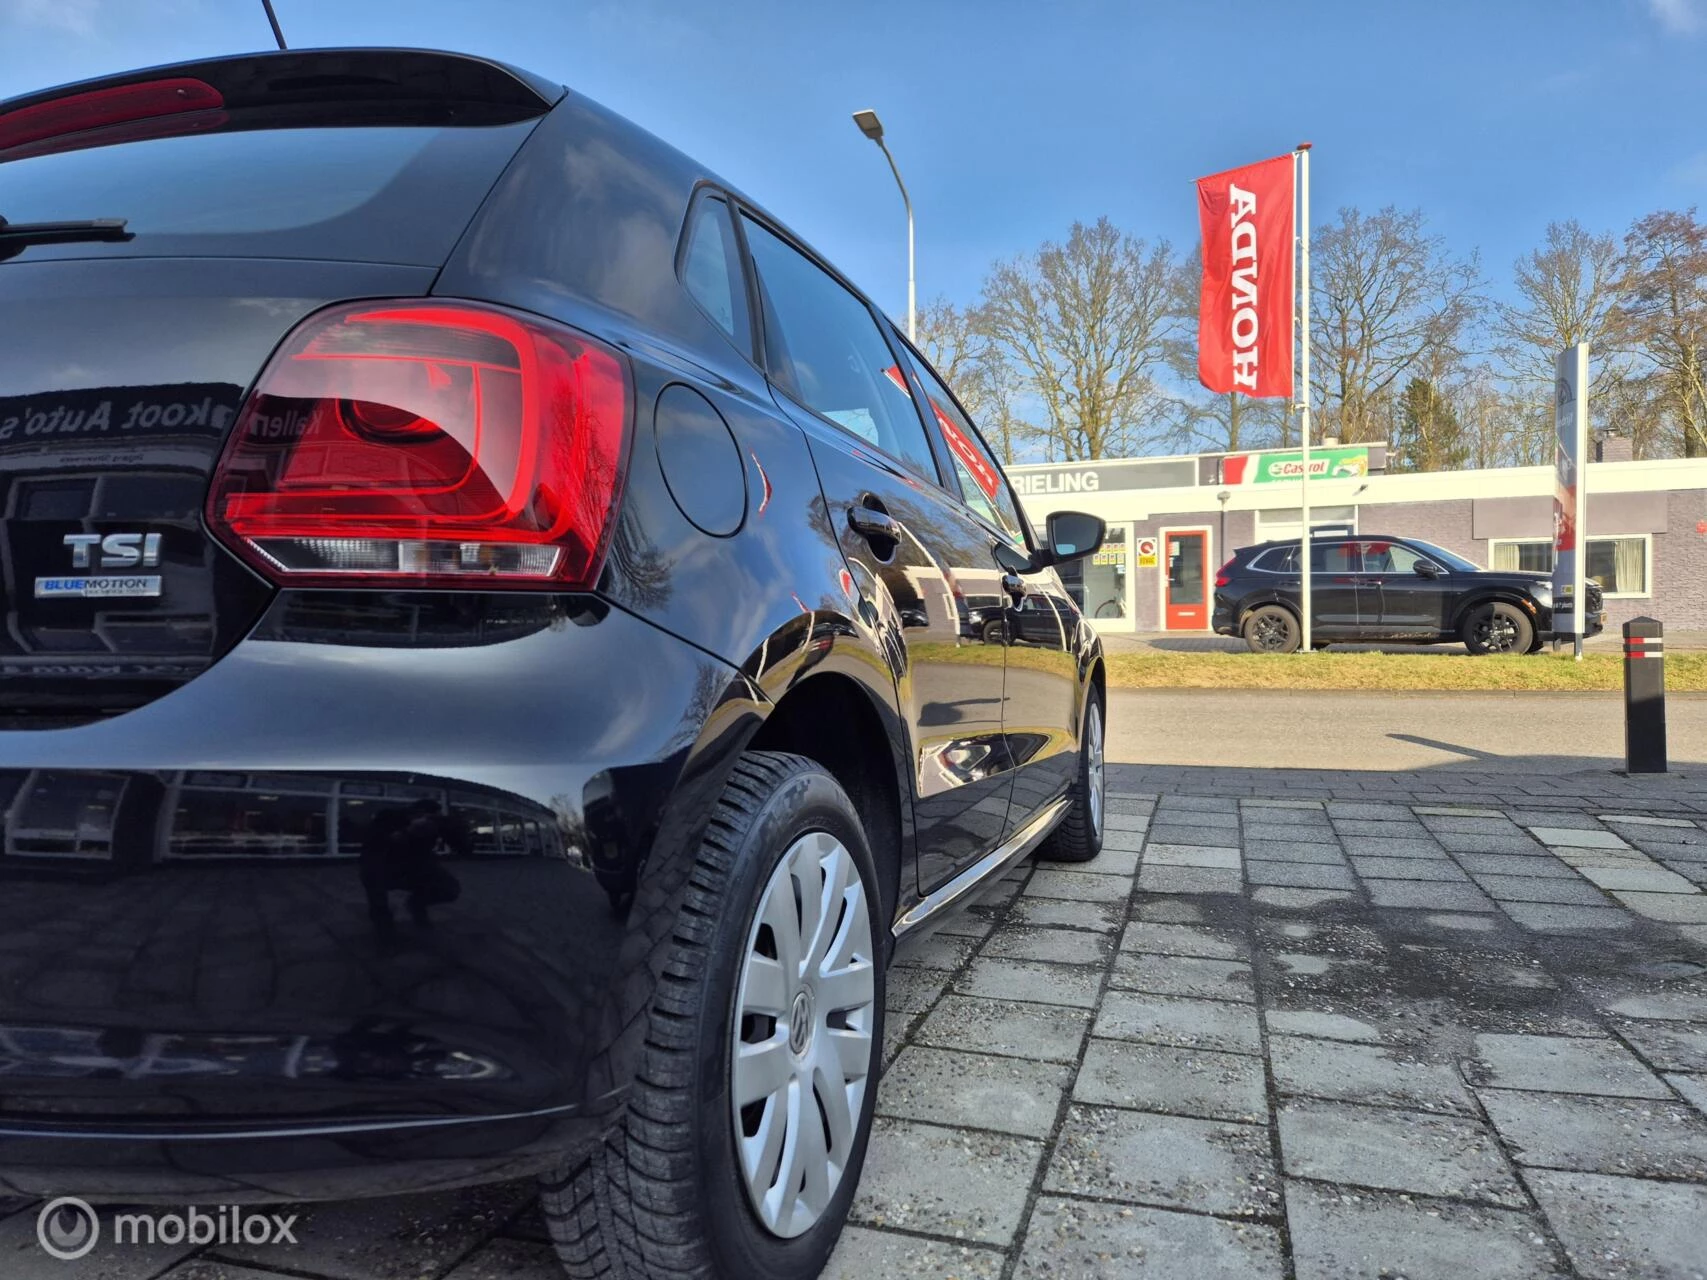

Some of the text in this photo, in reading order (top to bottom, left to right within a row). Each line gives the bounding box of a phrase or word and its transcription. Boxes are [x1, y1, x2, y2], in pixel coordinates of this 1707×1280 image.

[1229, 183, 1259, 390] HONDA
[1283, 461, 1325, 475] Casrol
[1008, 471, 1099, 494] RIELING
[63, 533, 163, 568] TSI
[44, 578, 148, 591] BLUEMOTION
